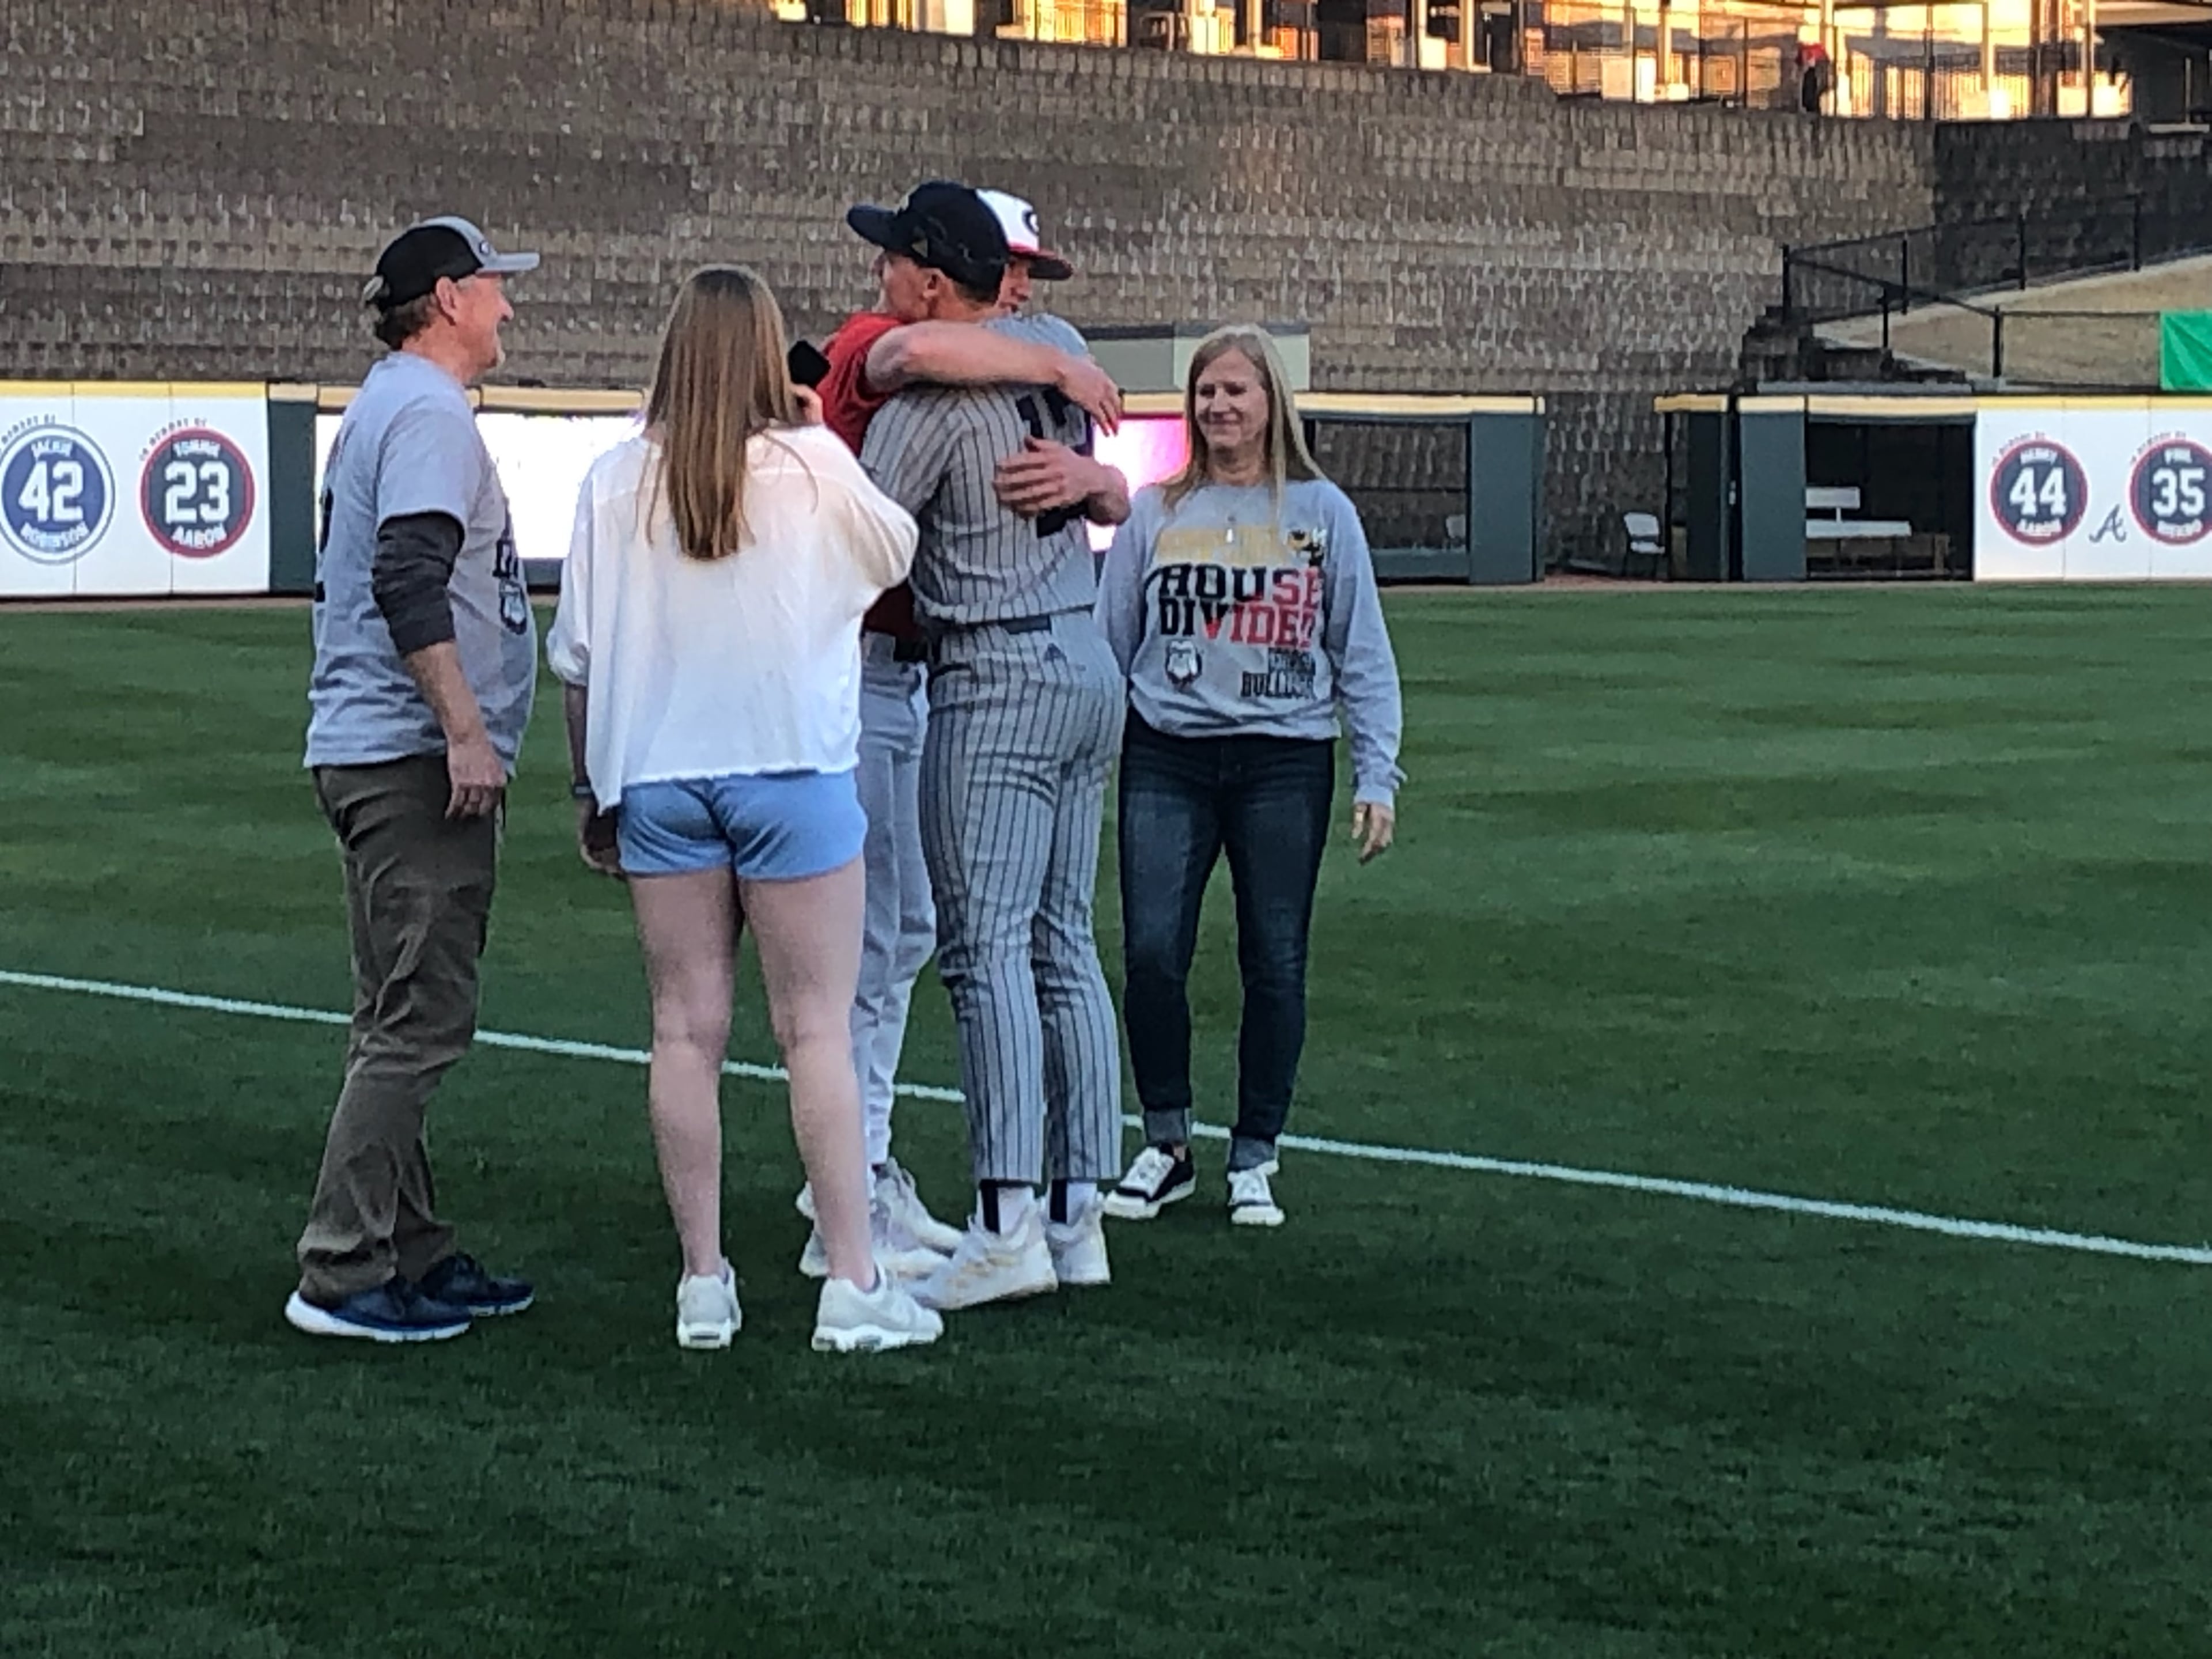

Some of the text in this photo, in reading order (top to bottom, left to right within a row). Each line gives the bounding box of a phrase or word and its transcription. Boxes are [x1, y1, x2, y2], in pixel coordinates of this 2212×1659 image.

[18, 461, 84, 522] 42
[165, 461, 229, 524] 23
[2009, 467, 2067, 517] 44
[2153, 468, 2205, 517] 35
